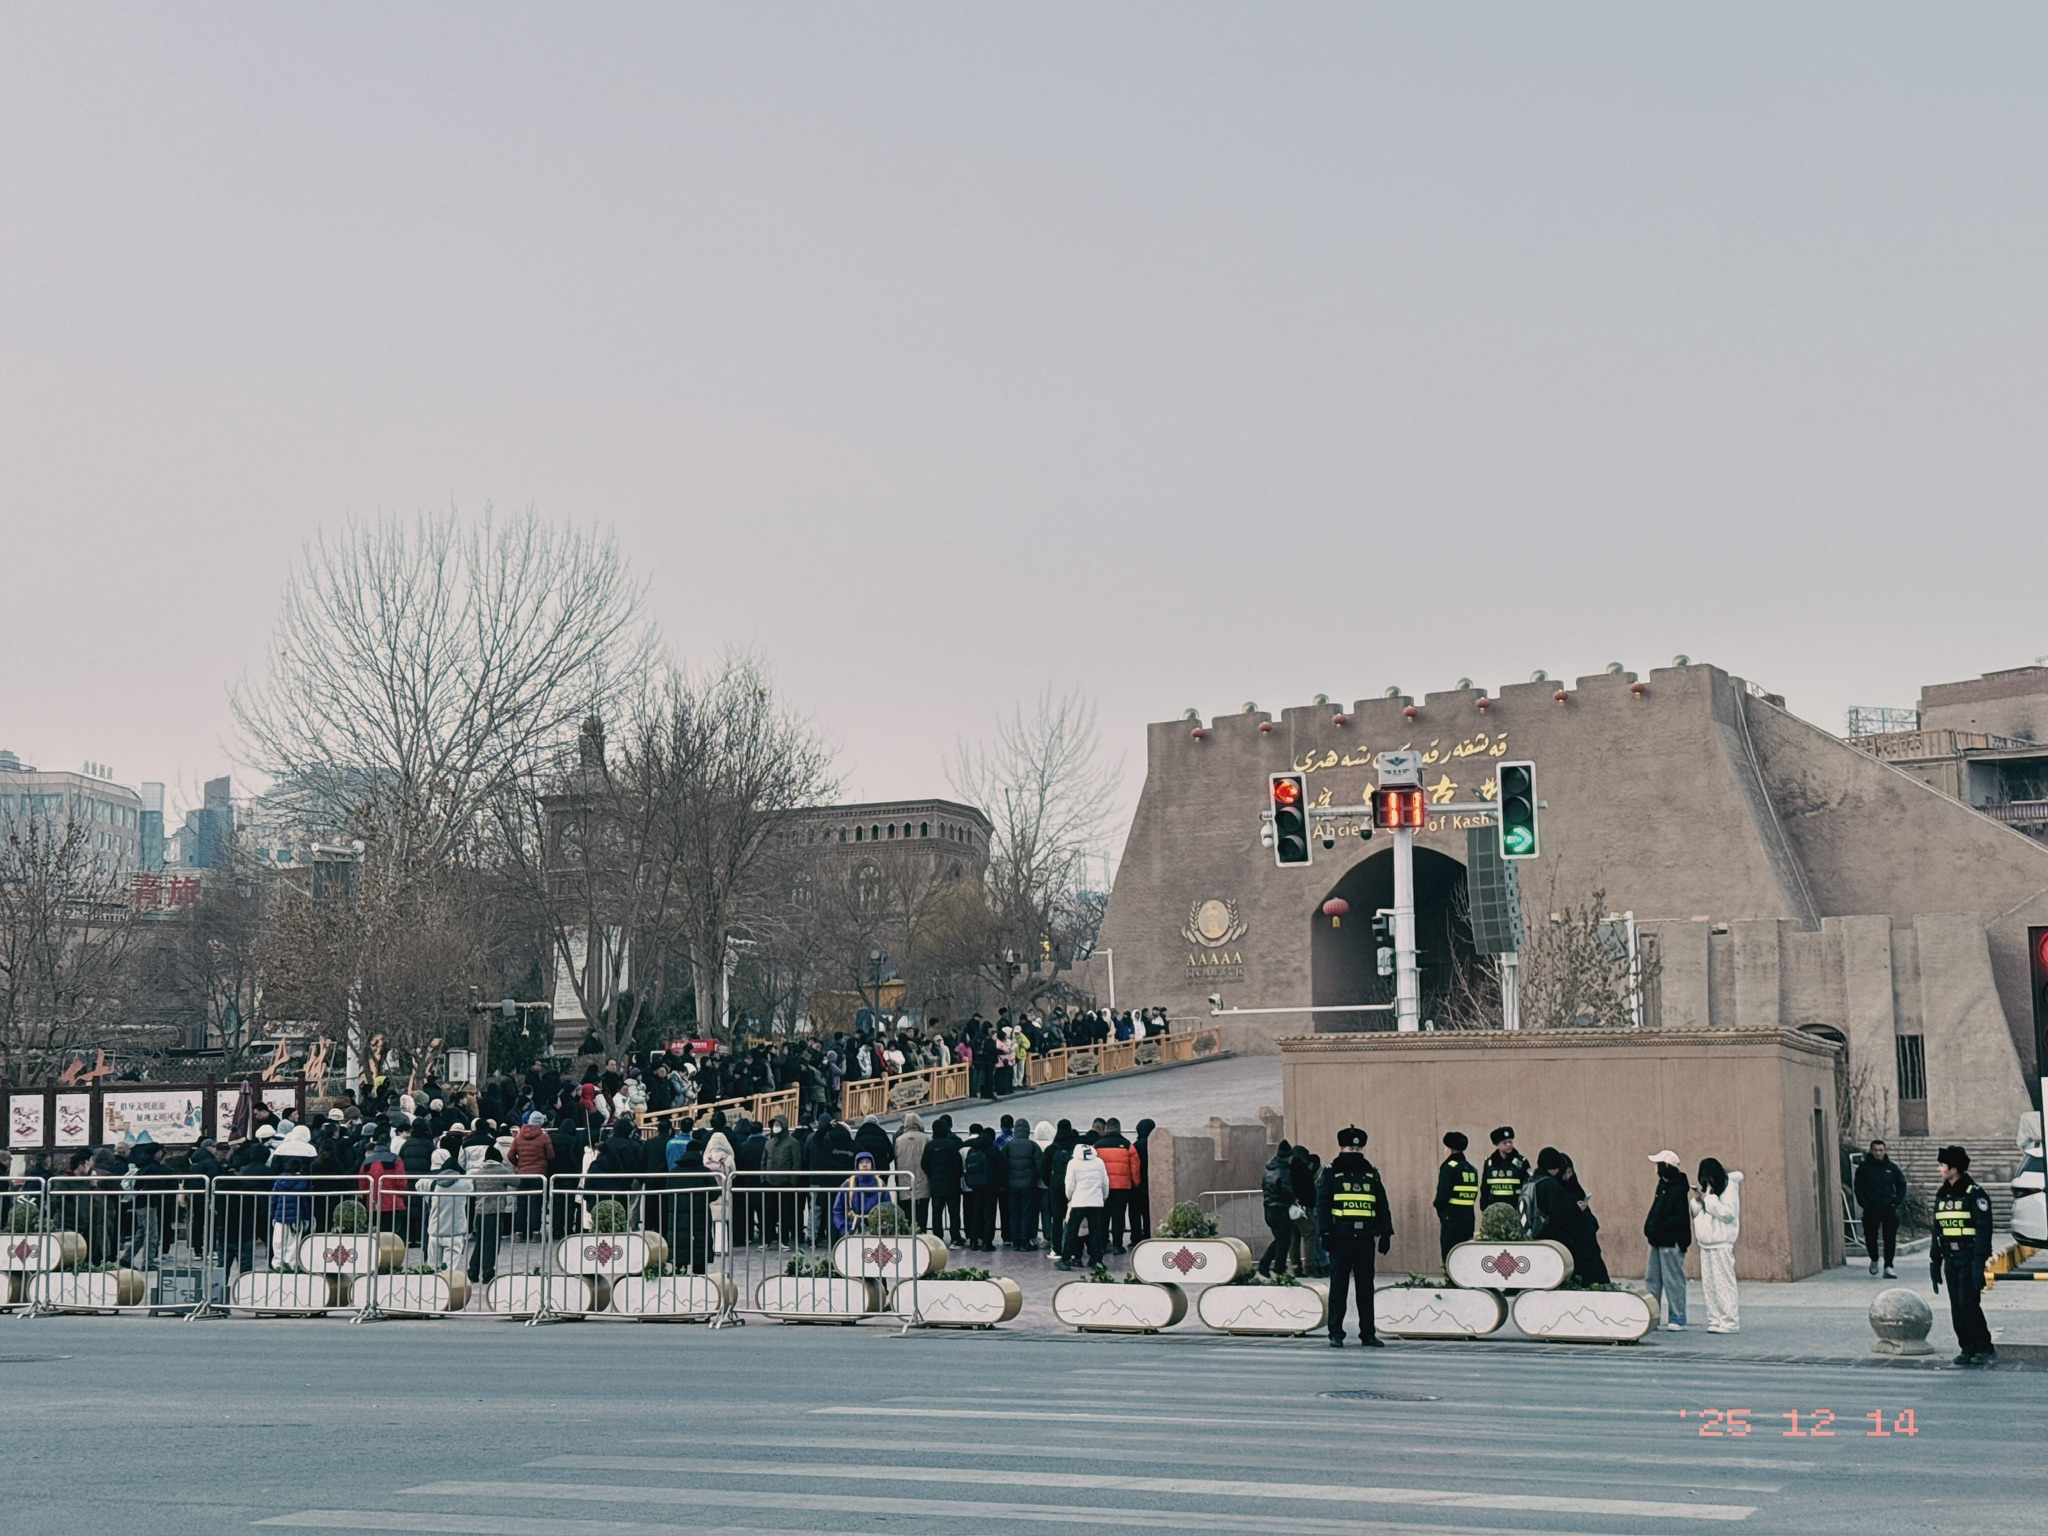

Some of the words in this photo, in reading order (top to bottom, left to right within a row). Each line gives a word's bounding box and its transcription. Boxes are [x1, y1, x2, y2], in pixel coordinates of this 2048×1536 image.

[1428, 815, 1446, 832] of
[1186, 951, 1243, 966] AAAAA
[1343, 1201, 1372, 1210] POLICE
